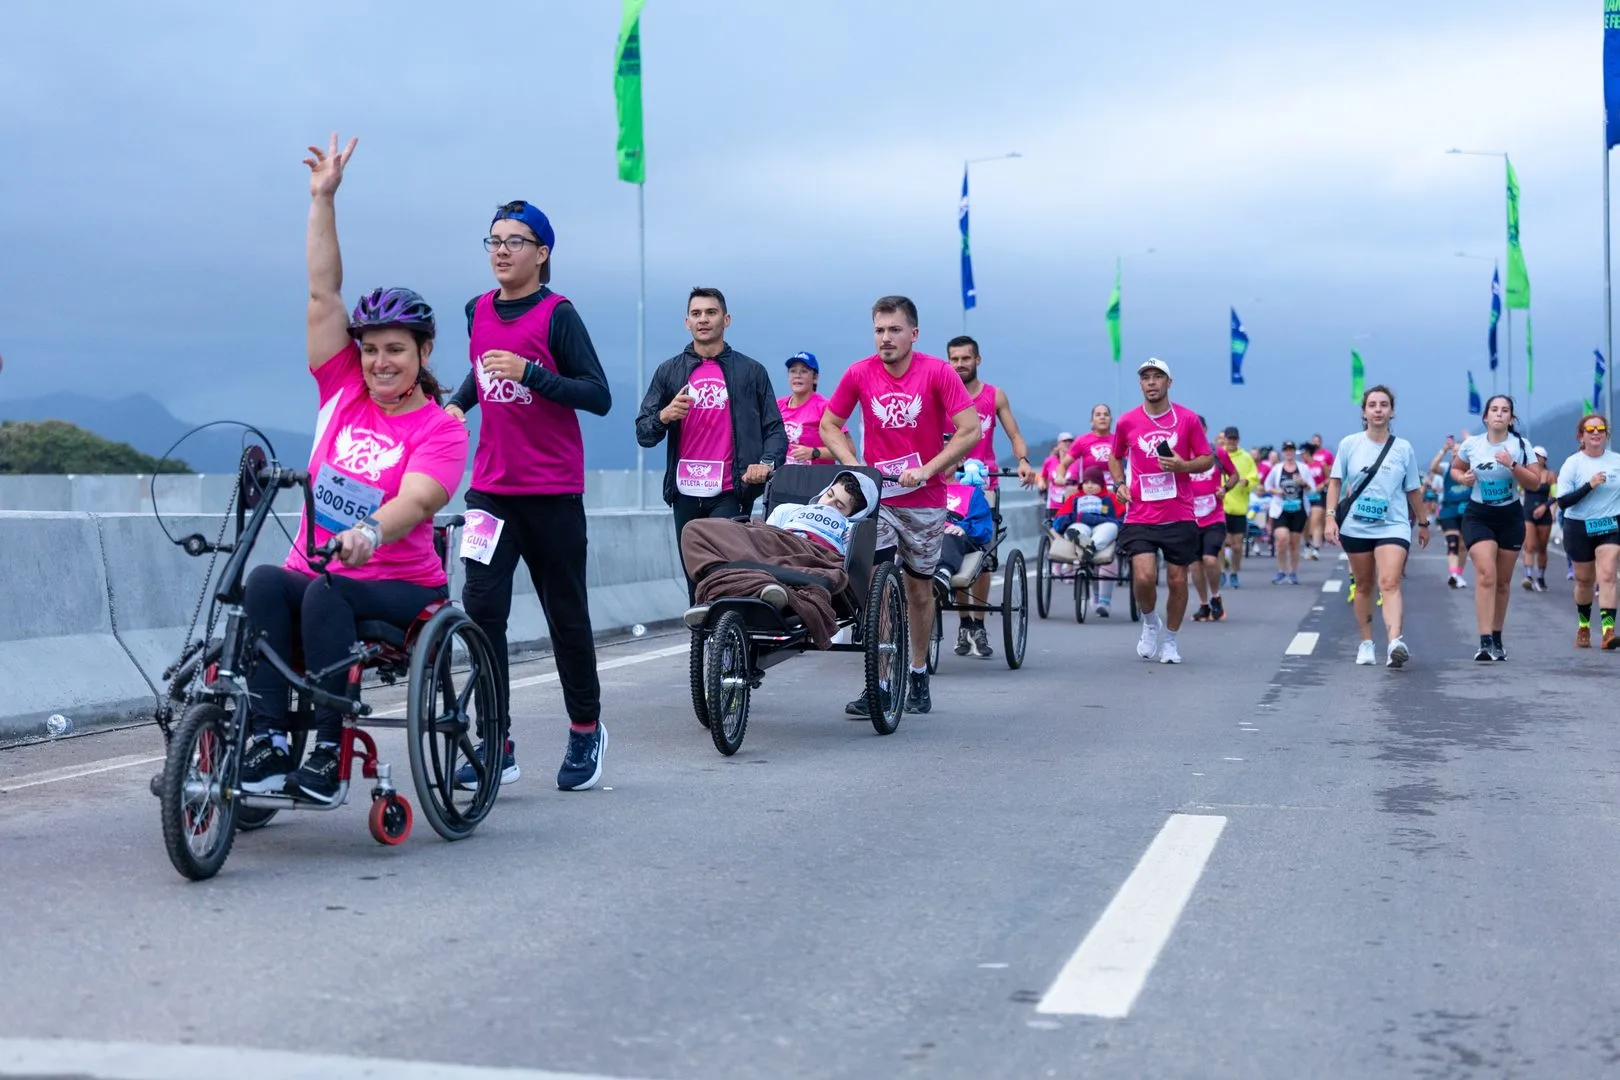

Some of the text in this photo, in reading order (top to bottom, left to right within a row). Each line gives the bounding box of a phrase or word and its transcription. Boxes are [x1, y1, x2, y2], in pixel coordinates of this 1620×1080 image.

[704, 480, 719, 488] GUIA
[315, 485, 369, 522] 30055
[1357, 503, 1383, 515] 14830
[797, 511, 840, 530] 30060
[1589, 519, 1613, 529] 13928
[467, 535, 489, 549] GUIA
